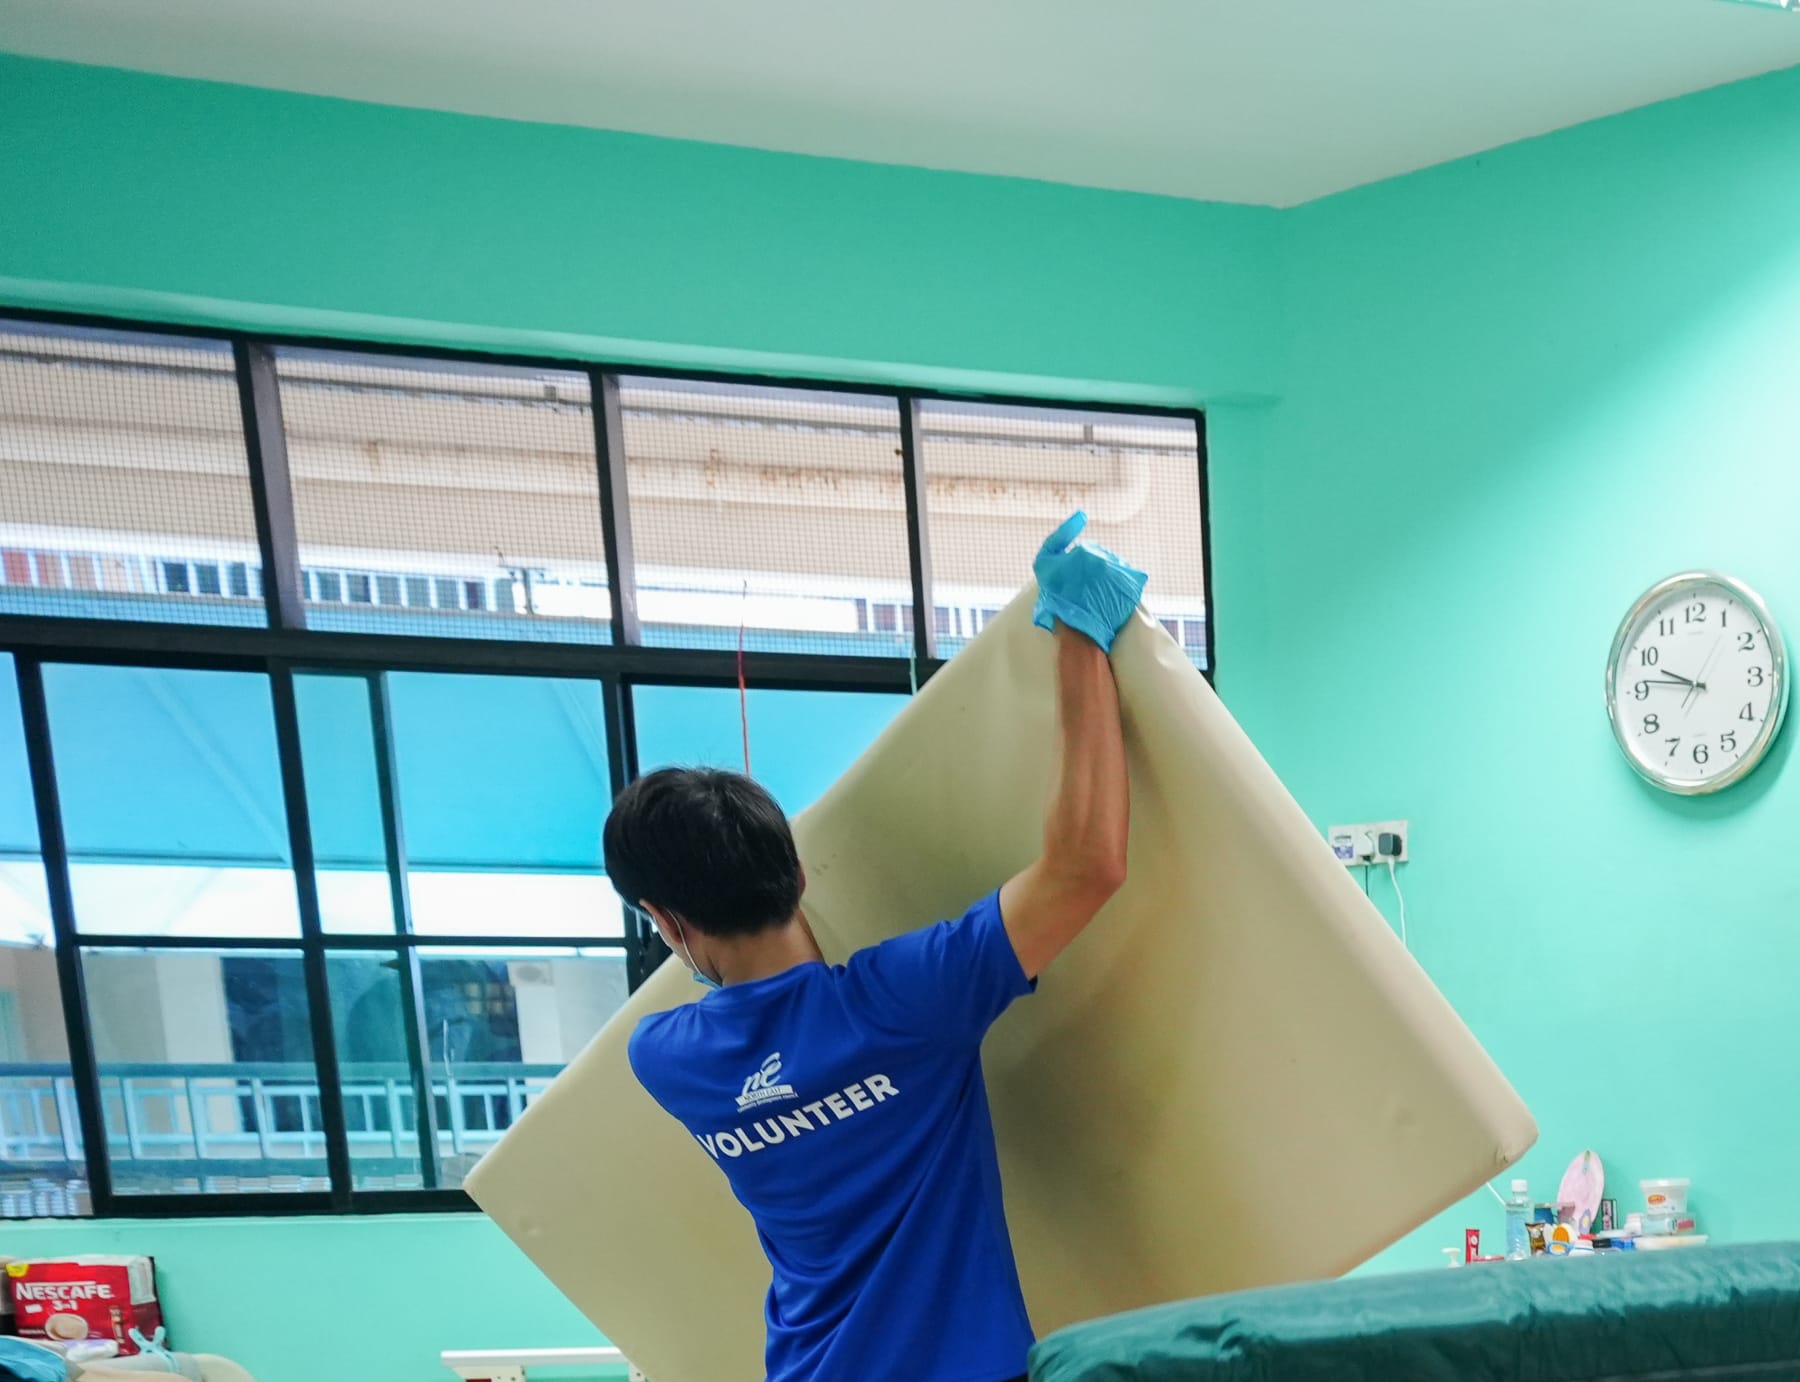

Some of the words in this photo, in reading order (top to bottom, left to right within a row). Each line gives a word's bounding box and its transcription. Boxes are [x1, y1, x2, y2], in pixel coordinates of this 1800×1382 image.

[1684, 602, 1707, 624] 12
[1719, 609, 1728, 628] 1
[1659, 618, 1675, 637] 11
[1737, 631, 1756, 652] 2
[1641, 646, 1659, 666] 10
[1747, 666, 1764, 687] 3
[1634, 681, 1650, 701] 9
[1738, 702, 1754, 722] 4
[1643, 713, 1660, 734] 8
[1665, 737, 1681, 757] 7
[1720, 730, 1737, 752] 5
[1692, 744, 1709, 764] 6
[697, 1073, 900, 1160] VOLUNTEER
